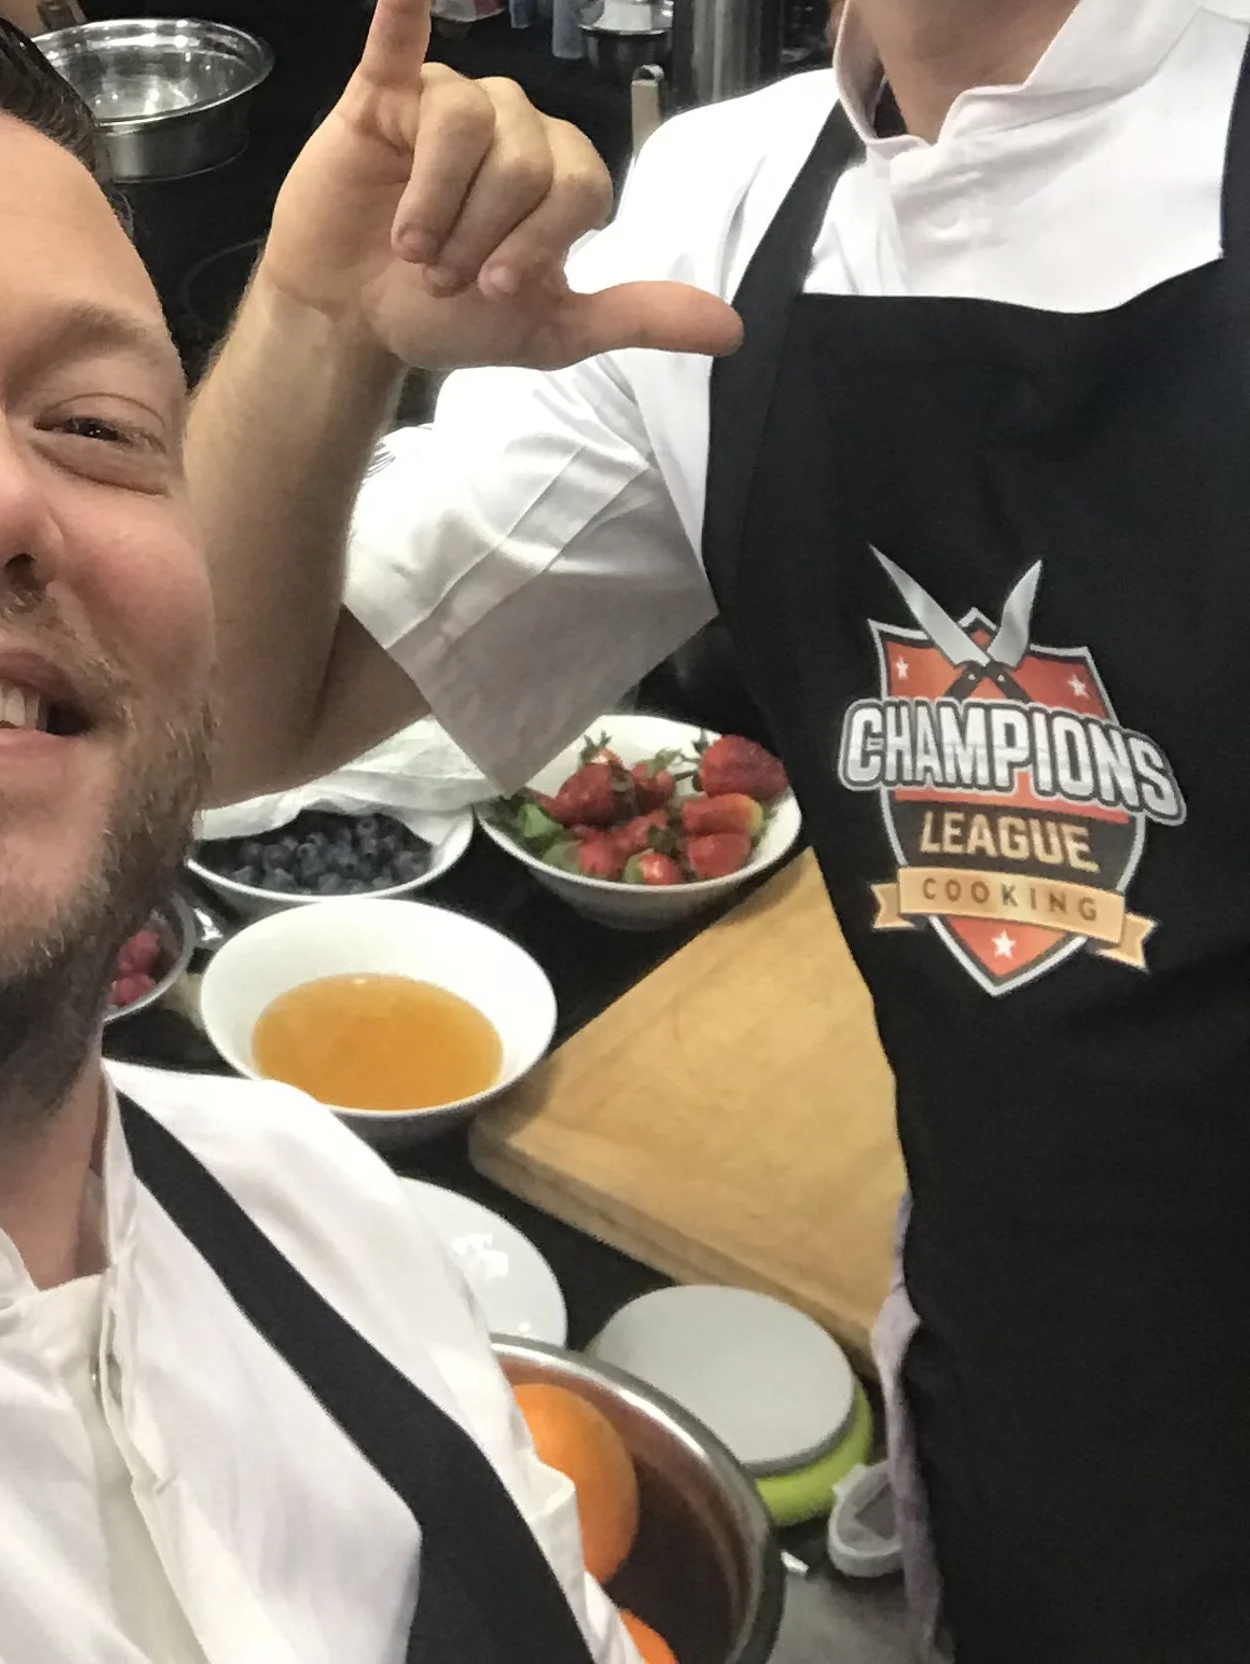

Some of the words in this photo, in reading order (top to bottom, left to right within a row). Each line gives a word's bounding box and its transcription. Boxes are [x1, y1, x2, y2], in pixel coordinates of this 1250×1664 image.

[846, 701, 1184, 821] CHAMPIONS
[919, 810, 1100, 874] LEAGUE
[922, 877, 1098, 922] COOKING
